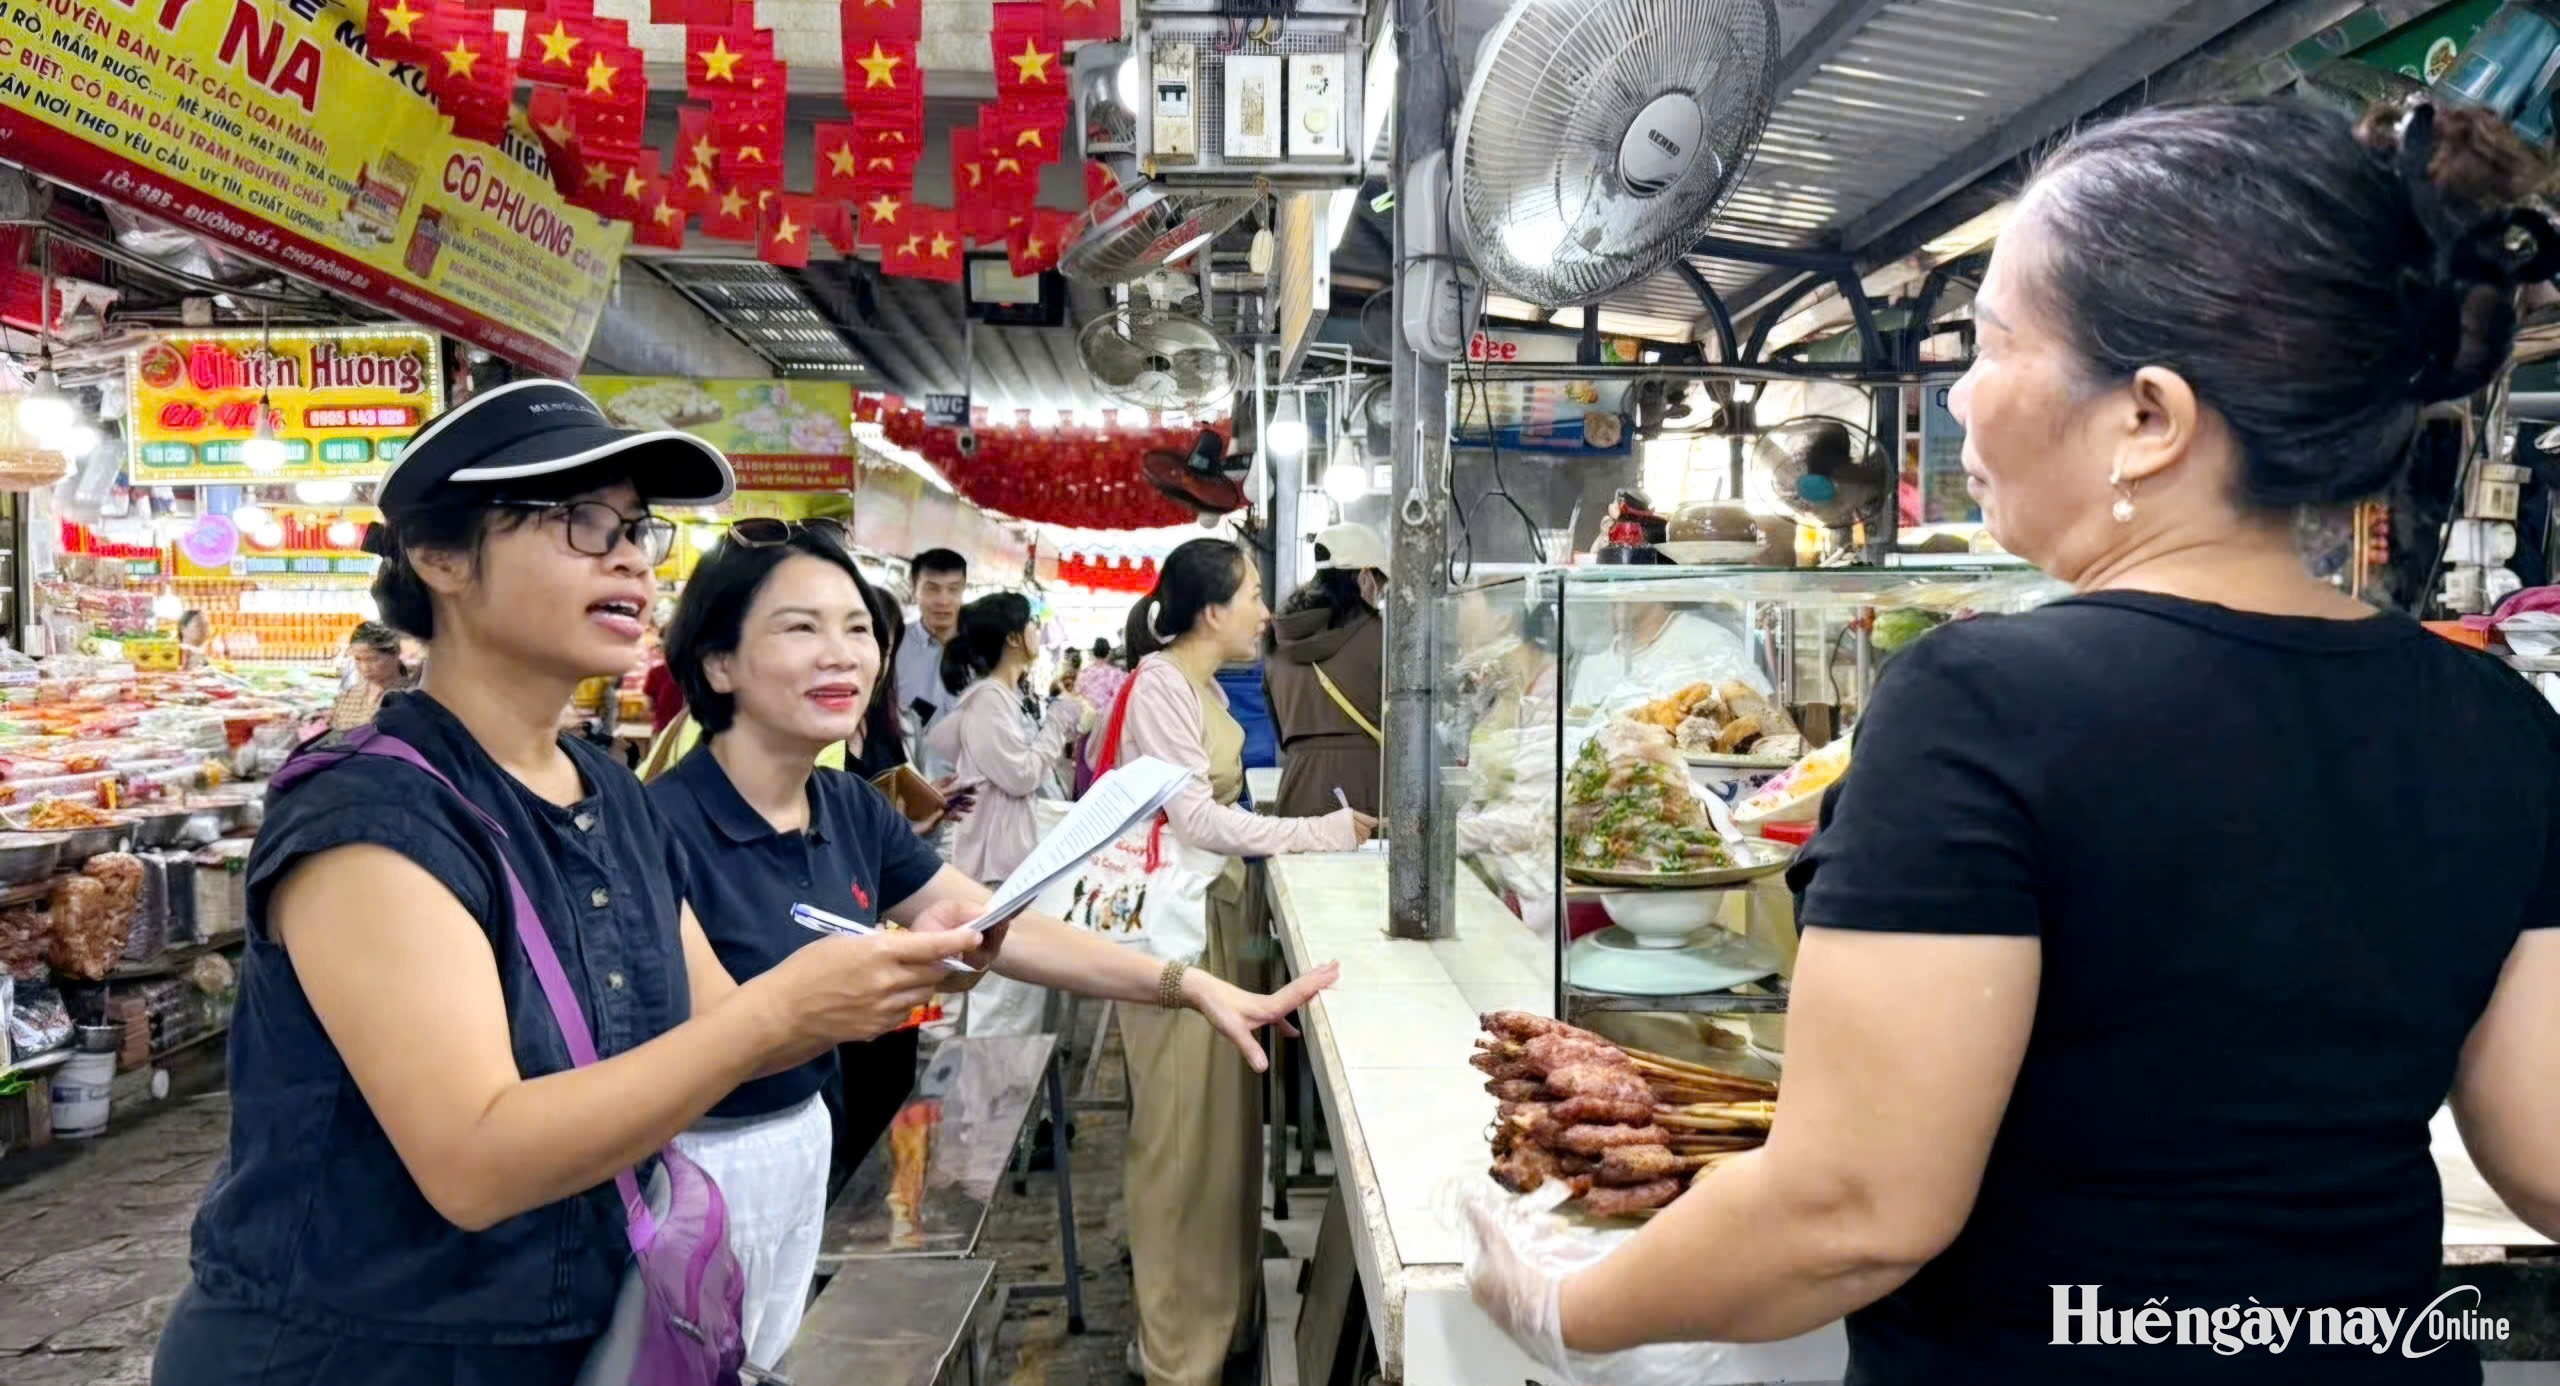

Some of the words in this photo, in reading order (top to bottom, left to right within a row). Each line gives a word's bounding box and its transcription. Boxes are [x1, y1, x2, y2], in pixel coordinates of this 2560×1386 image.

[219, 0, 321, 112] NA
[75, 107, 118, 139] THEO
[443, 153, 483, 202] CÔ
[1470, 333, 1517, 360] fee
[931, 396, 964, 414] WC
